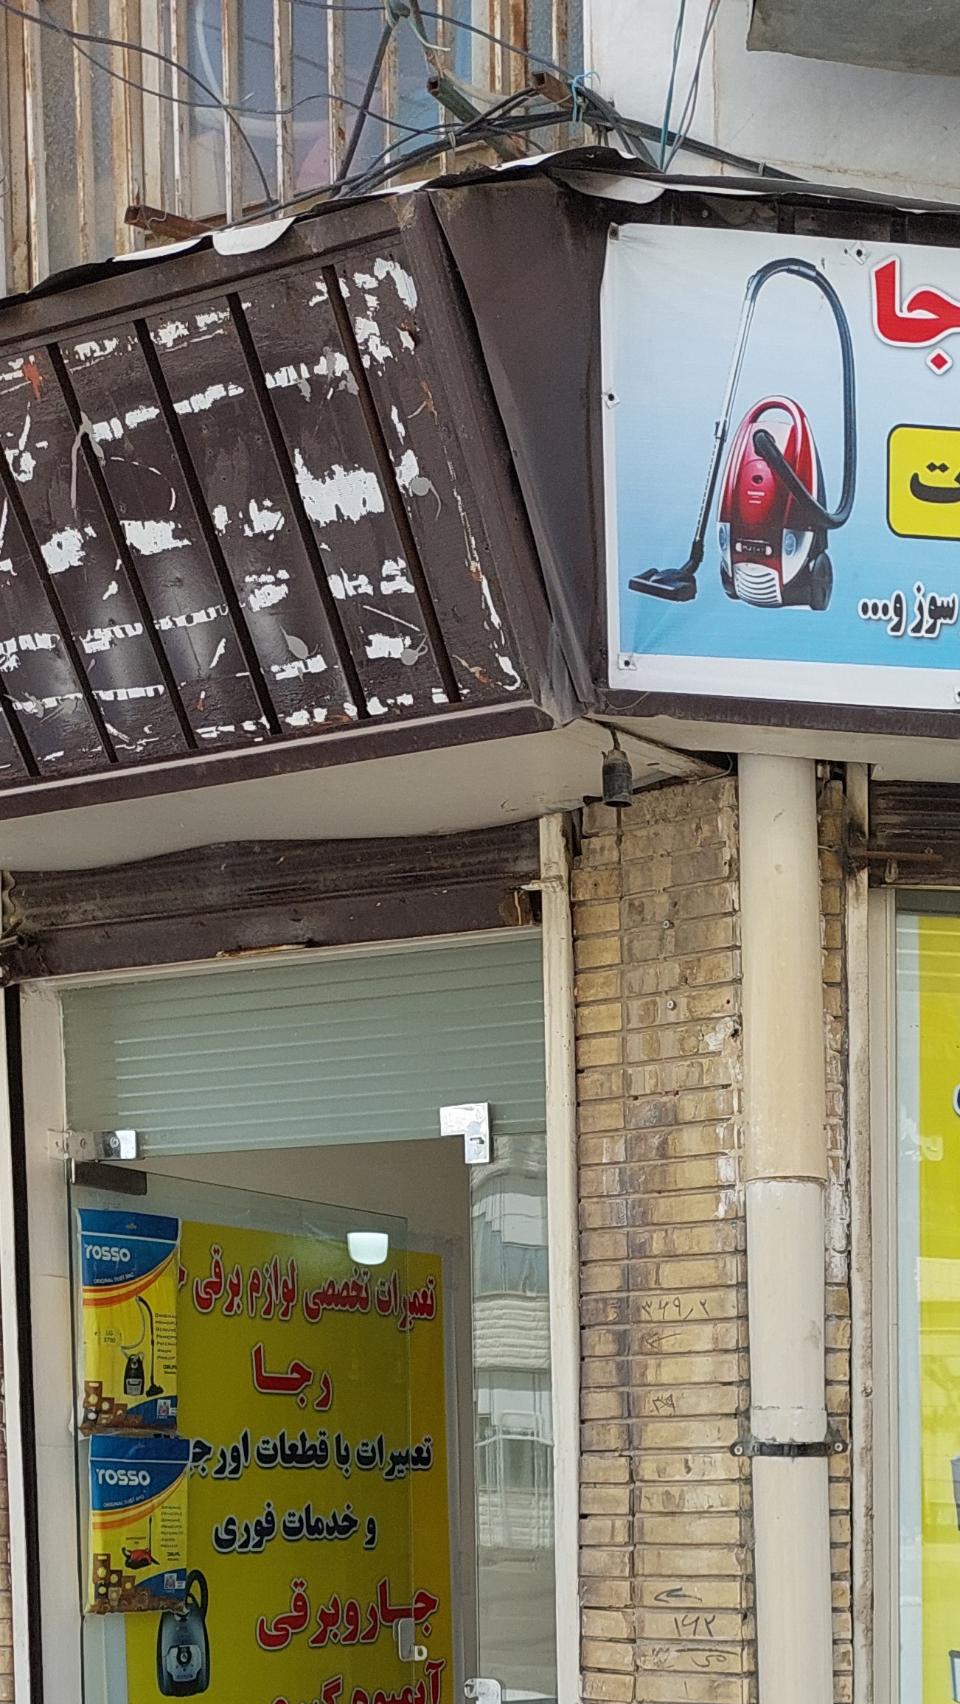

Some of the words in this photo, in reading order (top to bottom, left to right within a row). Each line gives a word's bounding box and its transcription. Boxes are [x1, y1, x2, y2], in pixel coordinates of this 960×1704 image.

[909, 580, 957, 638] سوز
[193, 1244, 243, 1316] برقی
[248, 1255, 297, 1320] لوازم
[303, 1266, 371, 1322] تخصصی
[251, 1342, 333, 1410] رجا
[256, 1428, 329, 1468] قطعات
[334, 1431, 351, 1477] با
[213, 1501, 276, 1552] فوری
[281, 1503, 359, 1540] خدمات
[364, 1516, 378, 1550] و
[257, 1578, 439, 1649] جاروبرقی
